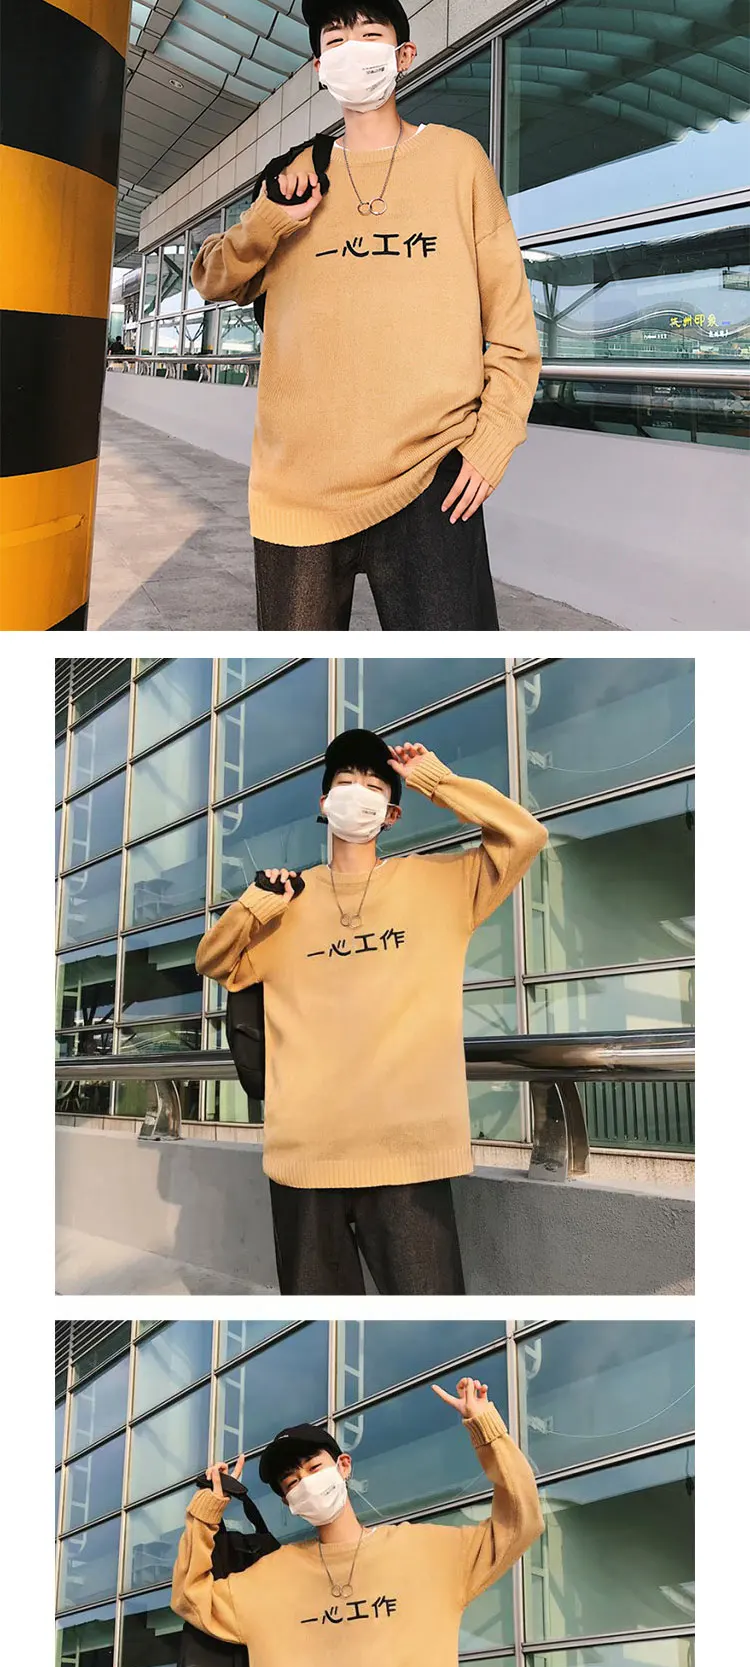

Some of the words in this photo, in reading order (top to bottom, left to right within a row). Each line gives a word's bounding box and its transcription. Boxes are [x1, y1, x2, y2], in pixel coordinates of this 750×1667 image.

[315, 232, 438, 258] 一心工作
[307, 928, 406, 958] 一心工作
[300, 1595, 397, 1625] 一心工作
